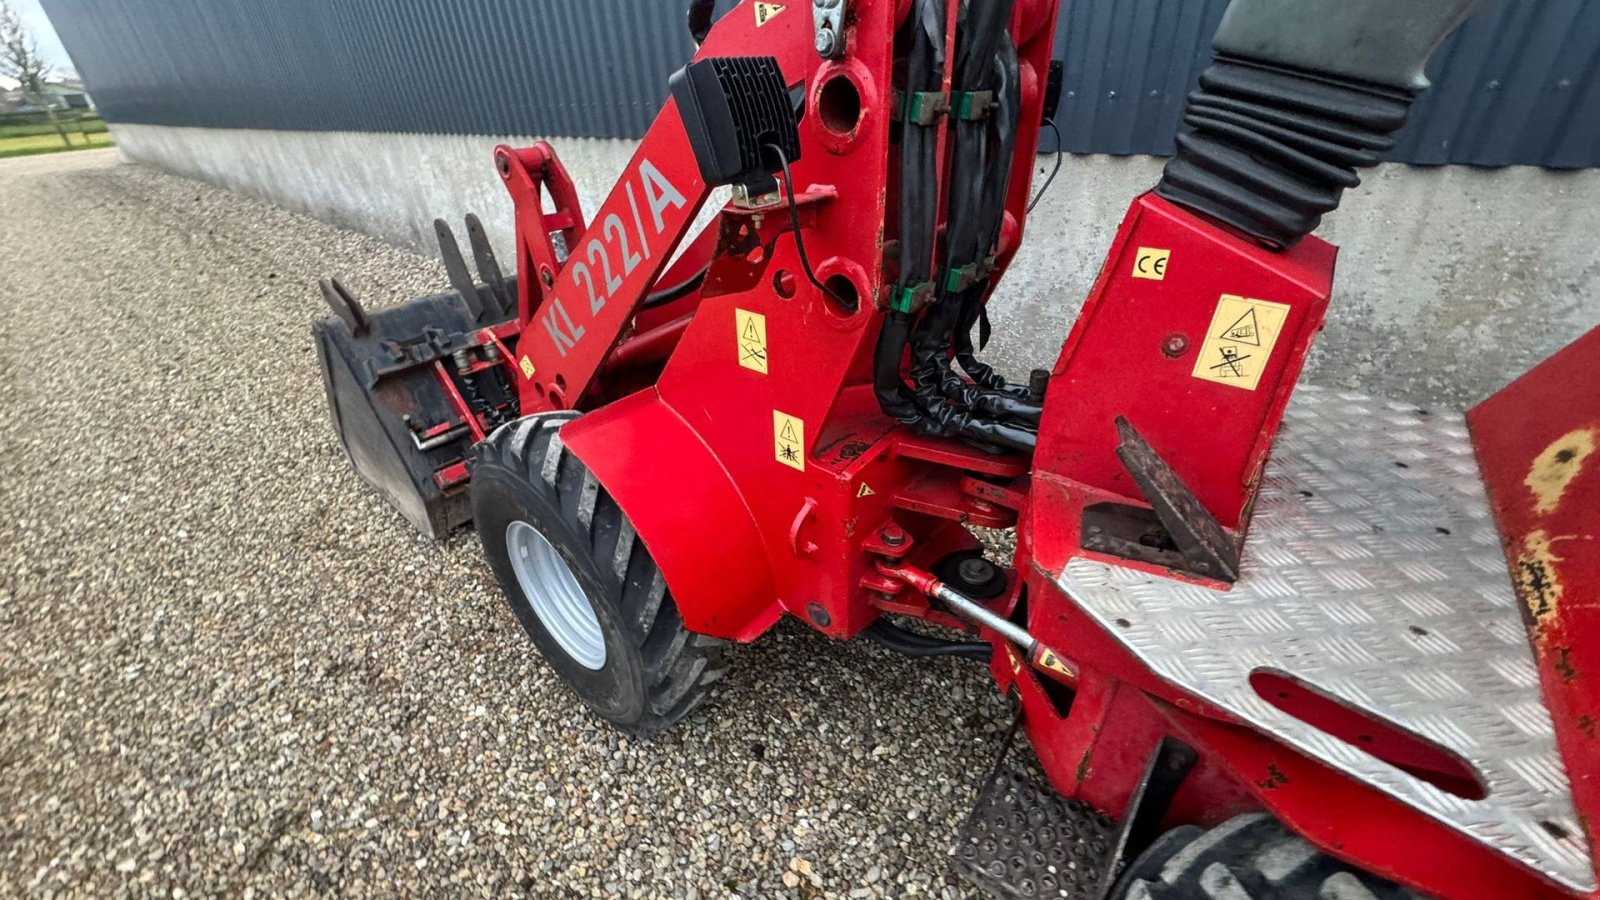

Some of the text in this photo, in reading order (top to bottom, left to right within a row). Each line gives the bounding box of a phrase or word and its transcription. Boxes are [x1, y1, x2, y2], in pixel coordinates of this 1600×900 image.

[541, 158, 688, 358] KL 222/A
[1138, 255, 1166, 275] CE
